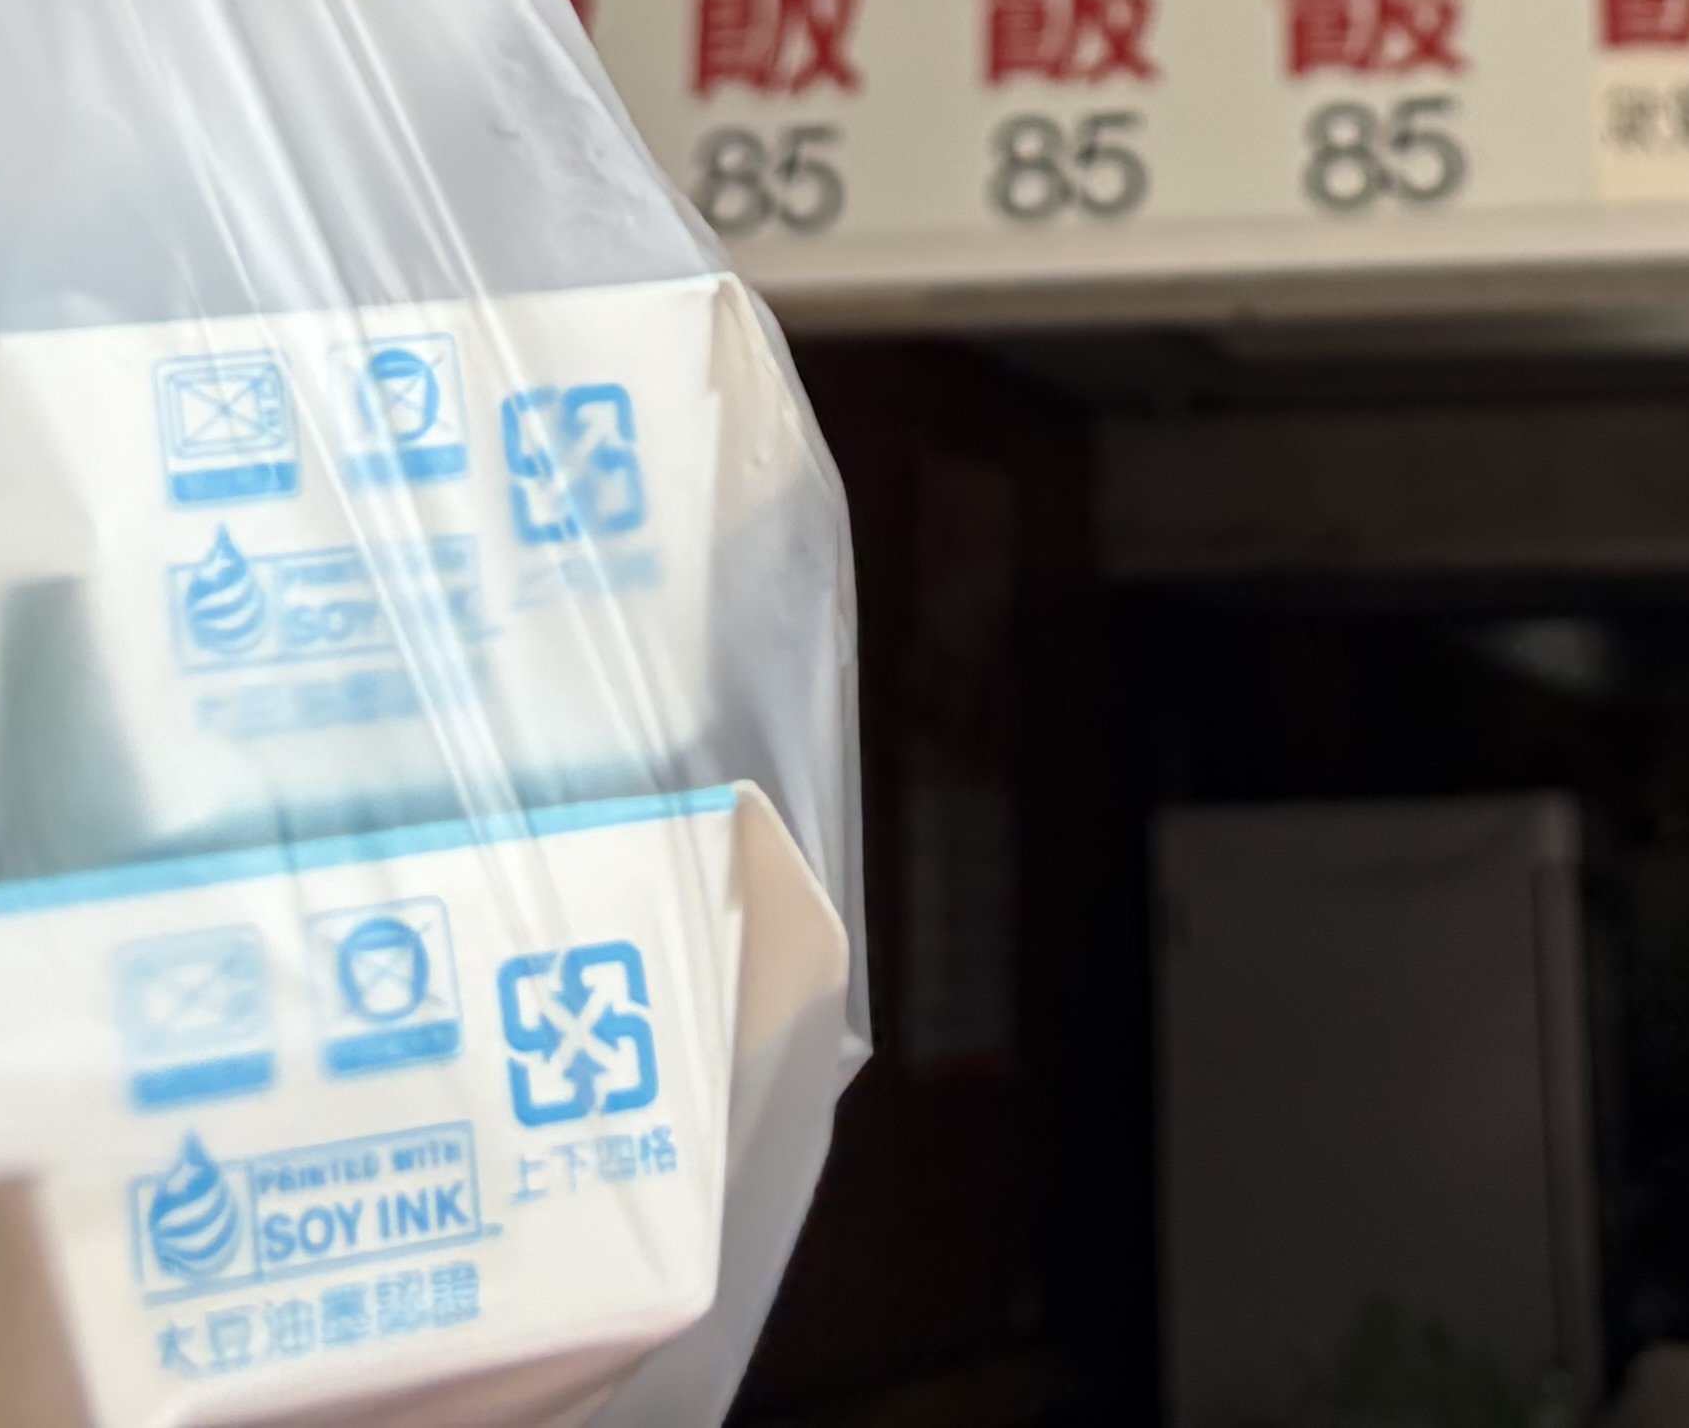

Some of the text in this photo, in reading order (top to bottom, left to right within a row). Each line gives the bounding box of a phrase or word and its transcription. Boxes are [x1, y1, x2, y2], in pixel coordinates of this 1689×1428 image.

[686, 122, 848, 244] 85
[987, 108, 1150, 226] 85
[1302, 94, 1468, 214] 85
[262, 1180, 471, 1264] SOY INK
